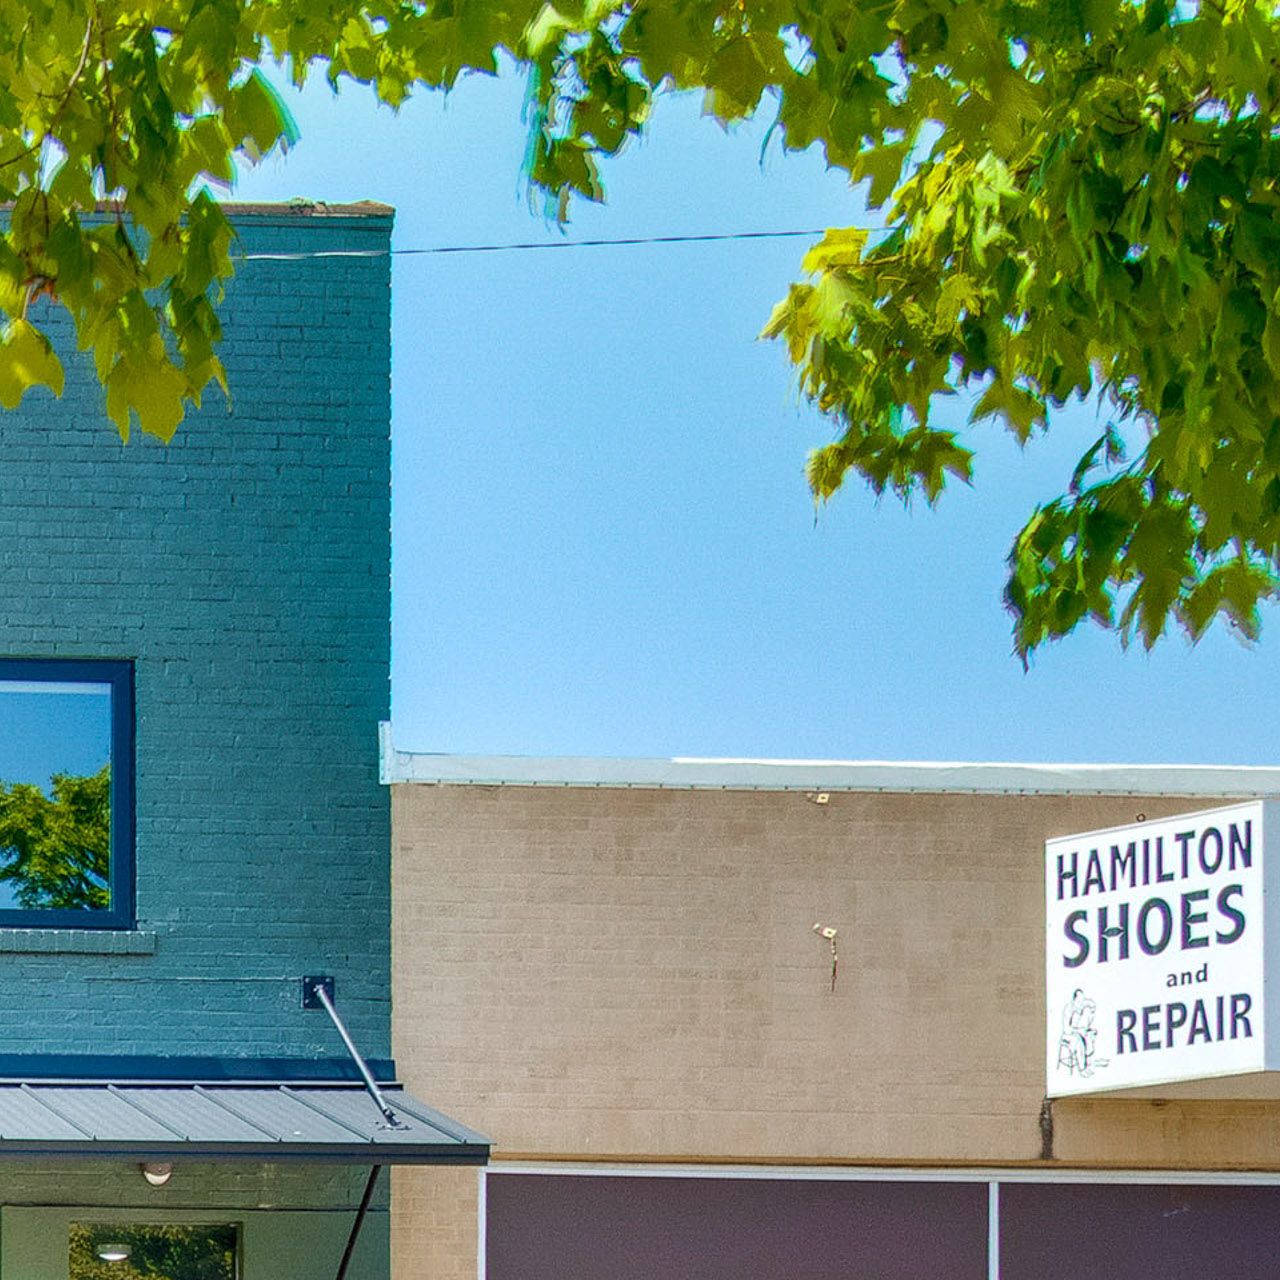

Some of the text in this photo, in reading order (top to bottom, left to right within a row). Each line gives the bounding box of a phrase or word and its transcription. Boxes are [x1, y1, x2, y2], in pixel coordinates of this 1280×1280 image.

[1056, 819, 1253, 901] HAMILTON
[1062, 883, 1247, 969] SHOES
[1165, 962, 1209, 988] and
[1116, 992, 1254, 1055] REPAIR
